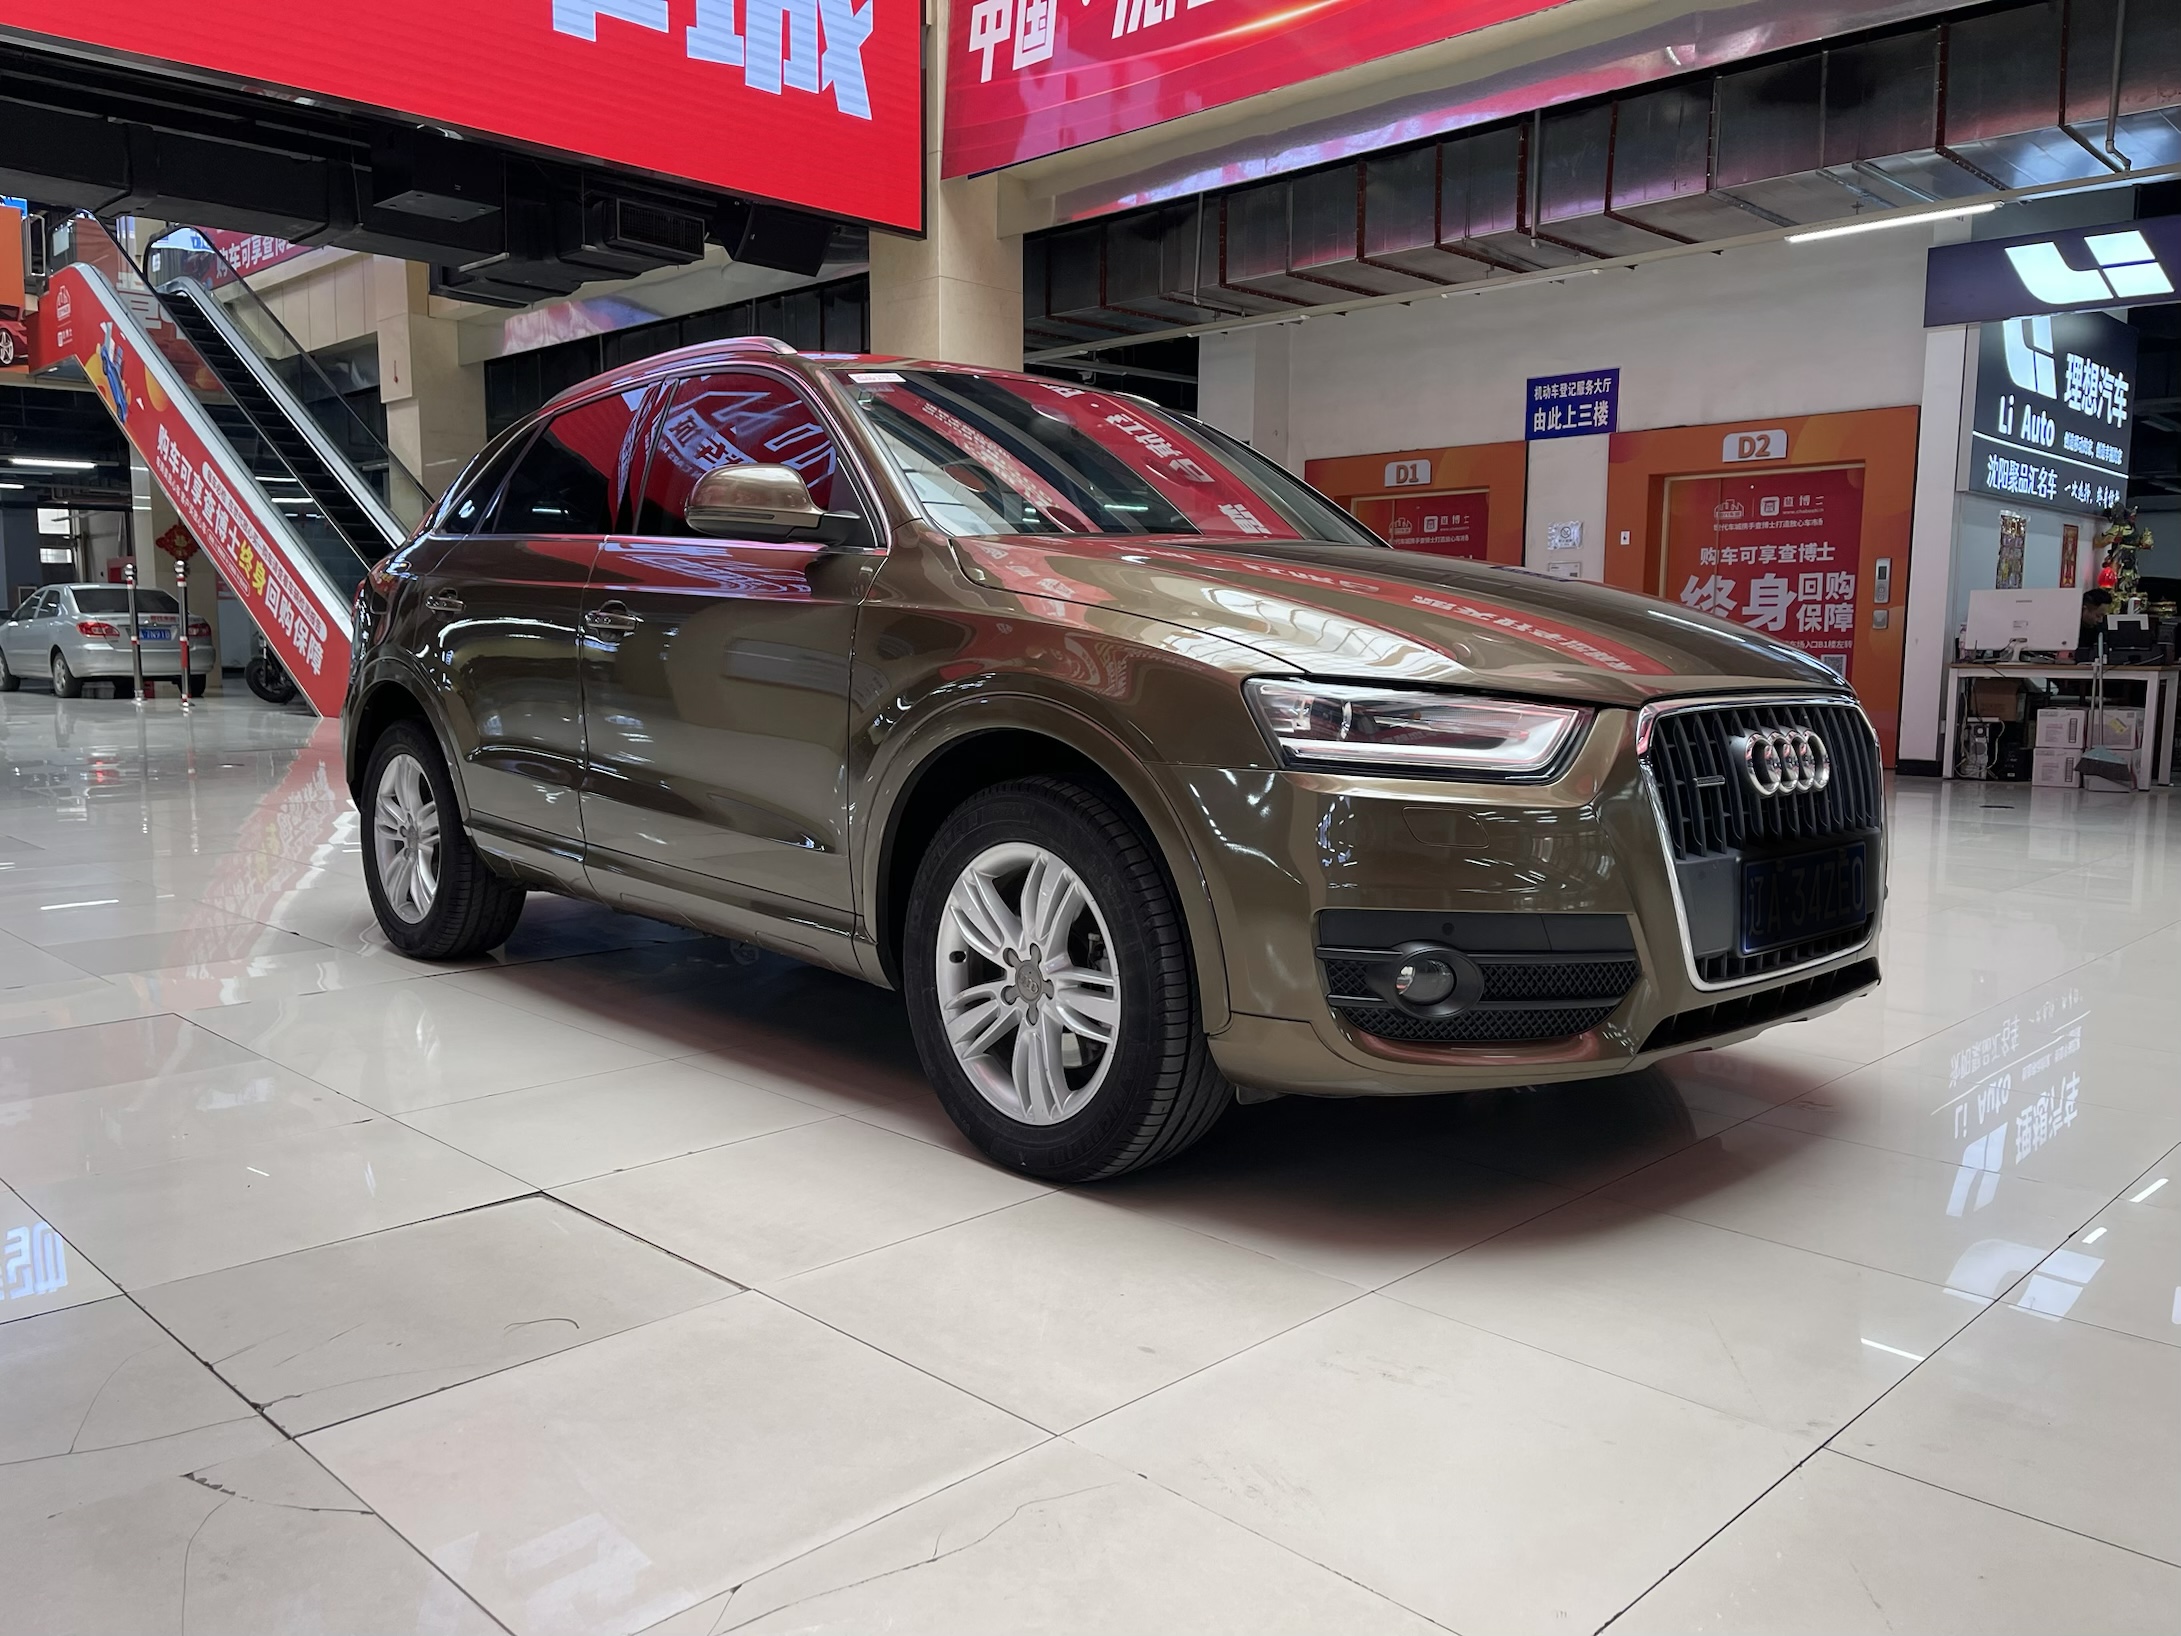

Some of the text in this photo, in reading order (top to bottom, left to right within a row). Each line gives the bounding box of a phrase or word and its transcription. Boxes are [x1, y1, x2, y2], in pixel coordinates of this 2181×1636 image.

[1534, 378, 1612, 400] 机动车登记服务大厅
[2064, 352, 2129, 429] 理想汽车
[1533, 401, 1609, 434] 由此上三楼
[1998, 394, 2055, 448] Li Auto
[1738, 435, 1771, 458] D2
[1395, 463, 1419, 485] D1
[1986, 453, 2058, 500] 沈阳聚品汇名车
[1700, 541, 1835, 566] 购车可享查博士
[1798, 571, 1855, 601] 回购
[1680, 572, 1797, 632] 终身
[1796, 603, 1854, 633] 保障
